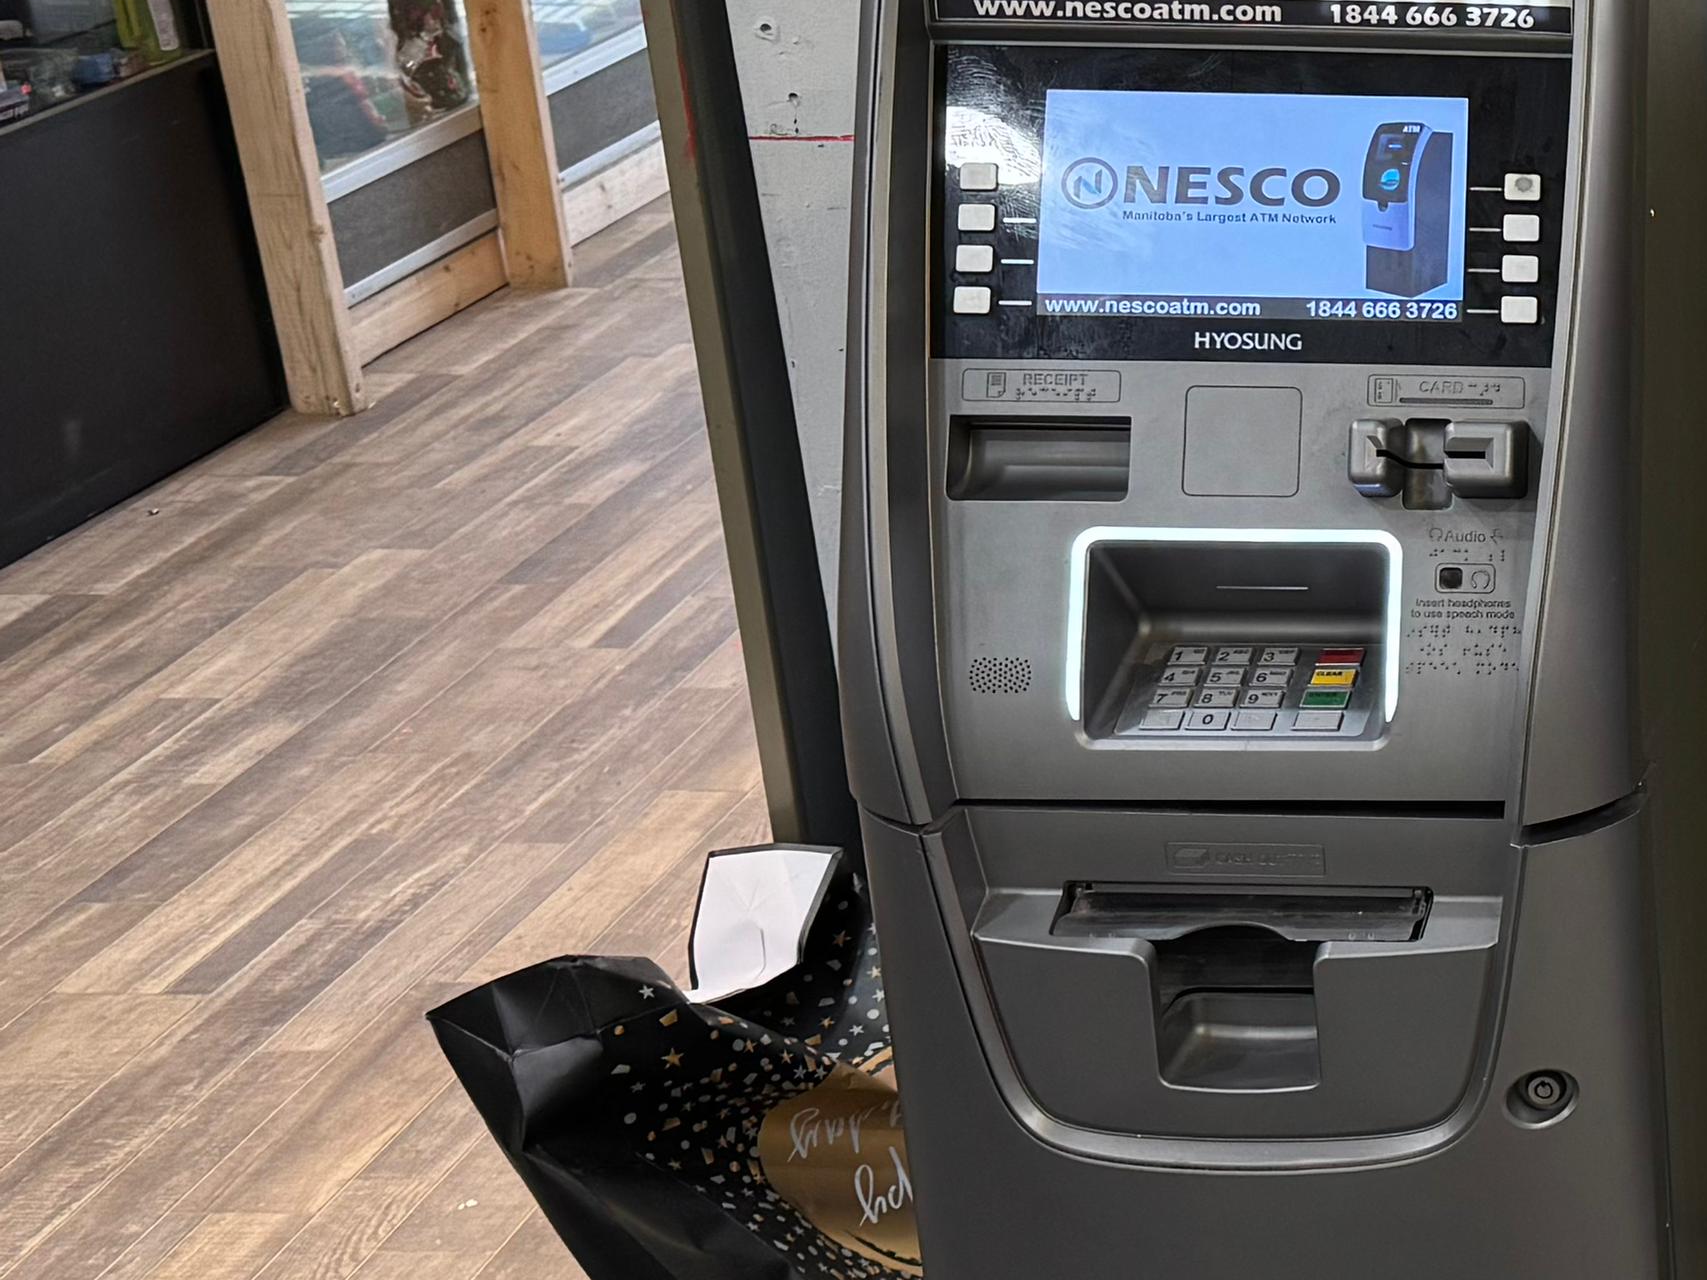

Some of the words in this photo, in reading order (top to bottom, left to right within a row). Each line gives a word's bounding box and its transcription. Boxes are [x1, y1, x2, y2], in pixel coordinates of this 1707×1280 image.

[1331, 4, 1397, 25] 1844
[1405, 5, 1457, 27] 666
[1465, 6, 1534, 28] 3726
[1123, 166, 1340, 207] NESCO
[1123, 211, 1193, 222] Manitoba's
[1197, 212, 1246, 224] Largest
[1250, 213, 1279, 223] ATM
[1282, 213, 1336, 224] Network
[1045, 299, 1260, 316] www.nescoatm.com
[1306, 302, 1356, 318] 1844
[1362, 303, 1400, 318] 666
[1405, 303, 1457, 319] 3726
[1194, 332, 1302, 351] HYOSUNG
[1022, 373, 1086, 387] RECEIPT
[1419, 381, 1463, 393] CARD
[1445, 529, 1485, 543] Audio
[1416, 598, 1444, 607] Insert
[1448, 598, 1511, 608] headphones
[1411, 610, 1421, 618] to
[1447, 609, 1483, 620] speech
[1486, 610, 1515, 619] mode
